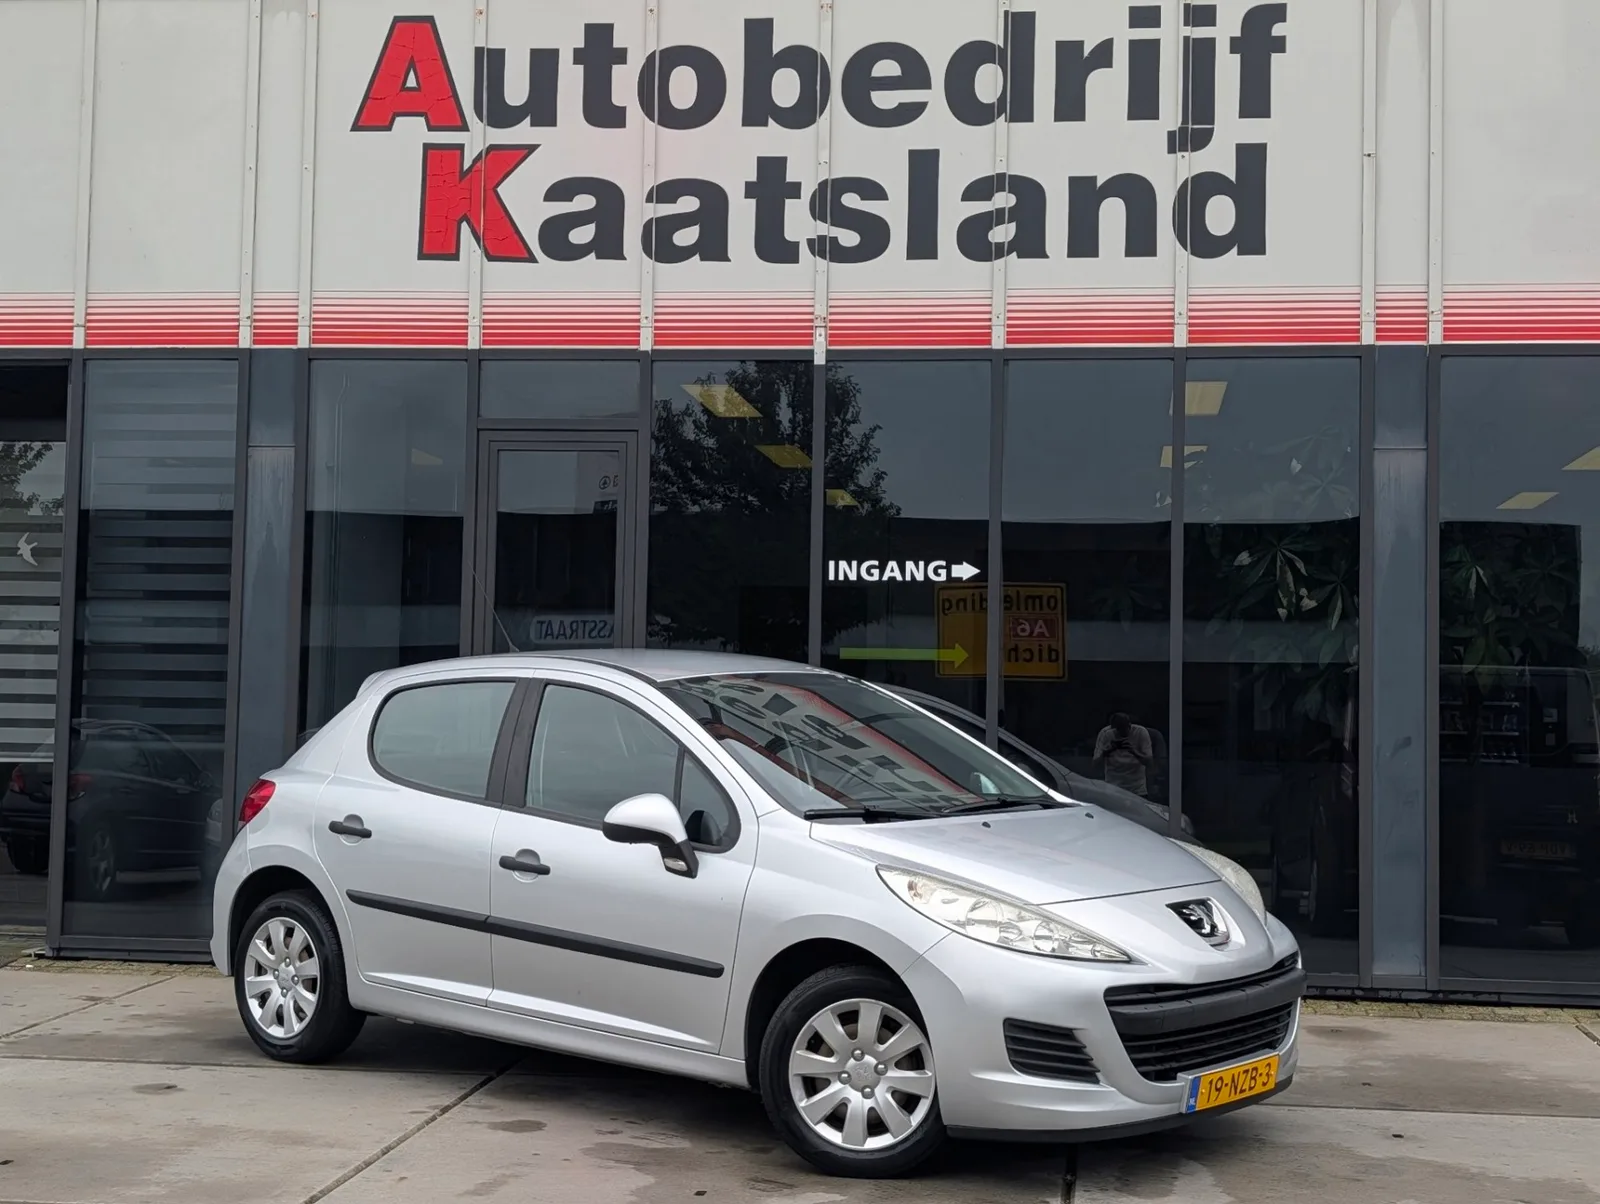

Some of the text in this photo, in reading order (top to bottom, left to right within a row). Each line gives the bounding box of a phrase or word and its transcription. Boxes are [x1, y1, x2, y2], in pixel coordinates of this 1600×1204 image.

[350, 3, 1287, 154] Autobedrijf
[417, 142, 1268, 264] Kaatsland
[828, 560, 947, 581] INGANG
[1207, 1062, 1271, 1103] 19-NZB-3
